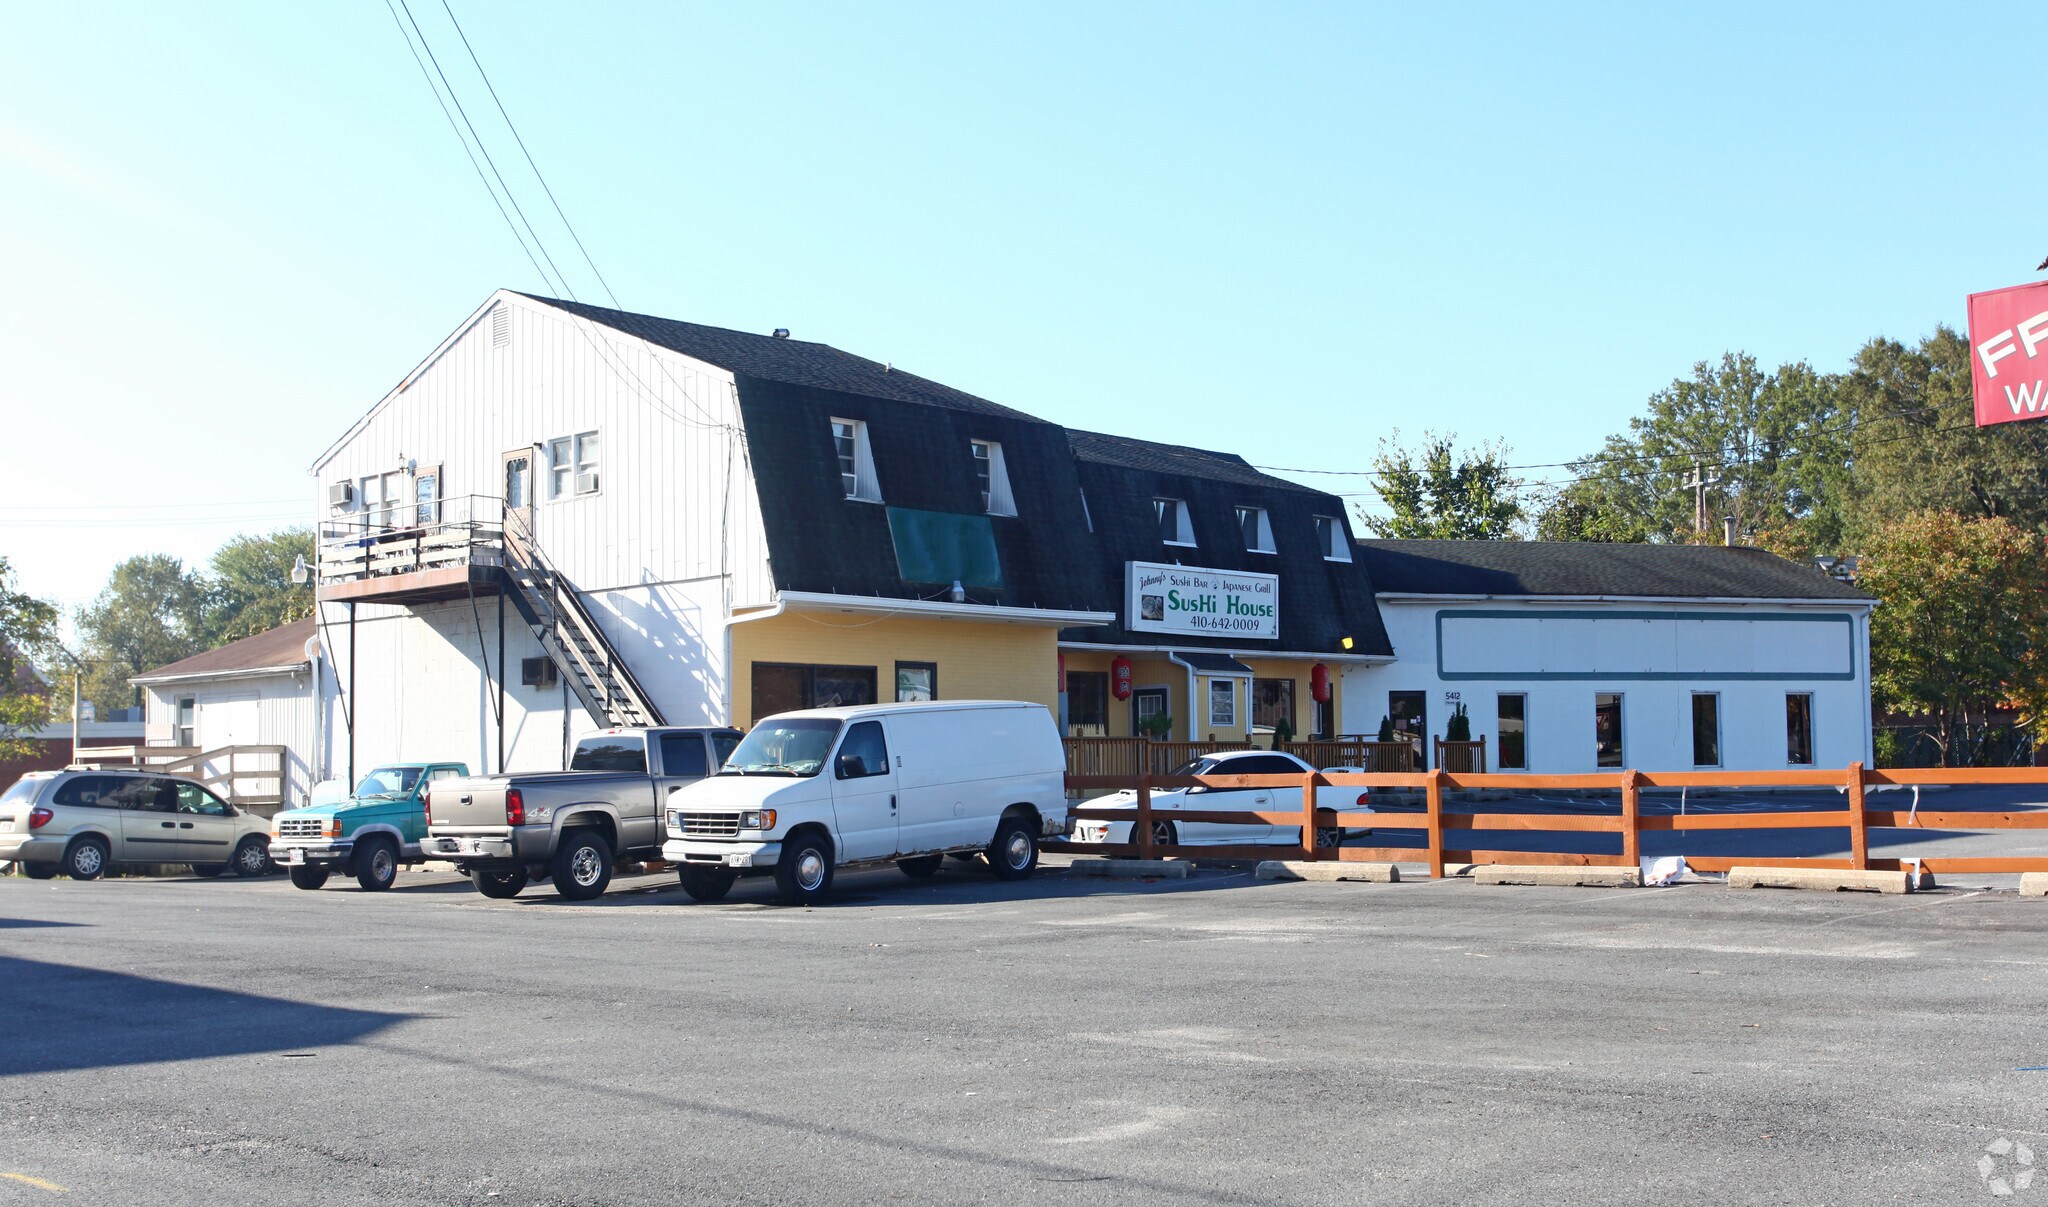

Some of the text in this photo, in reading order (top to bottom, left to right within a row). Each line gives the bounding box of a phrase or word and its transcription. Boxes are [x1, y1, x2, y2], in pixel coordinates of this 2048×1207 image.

[1139, 571, 1166, 591] Johnny's
[1190, 616, 1259, 631] 410-642-0009
[1445, 691, 1461, 700] 5412
